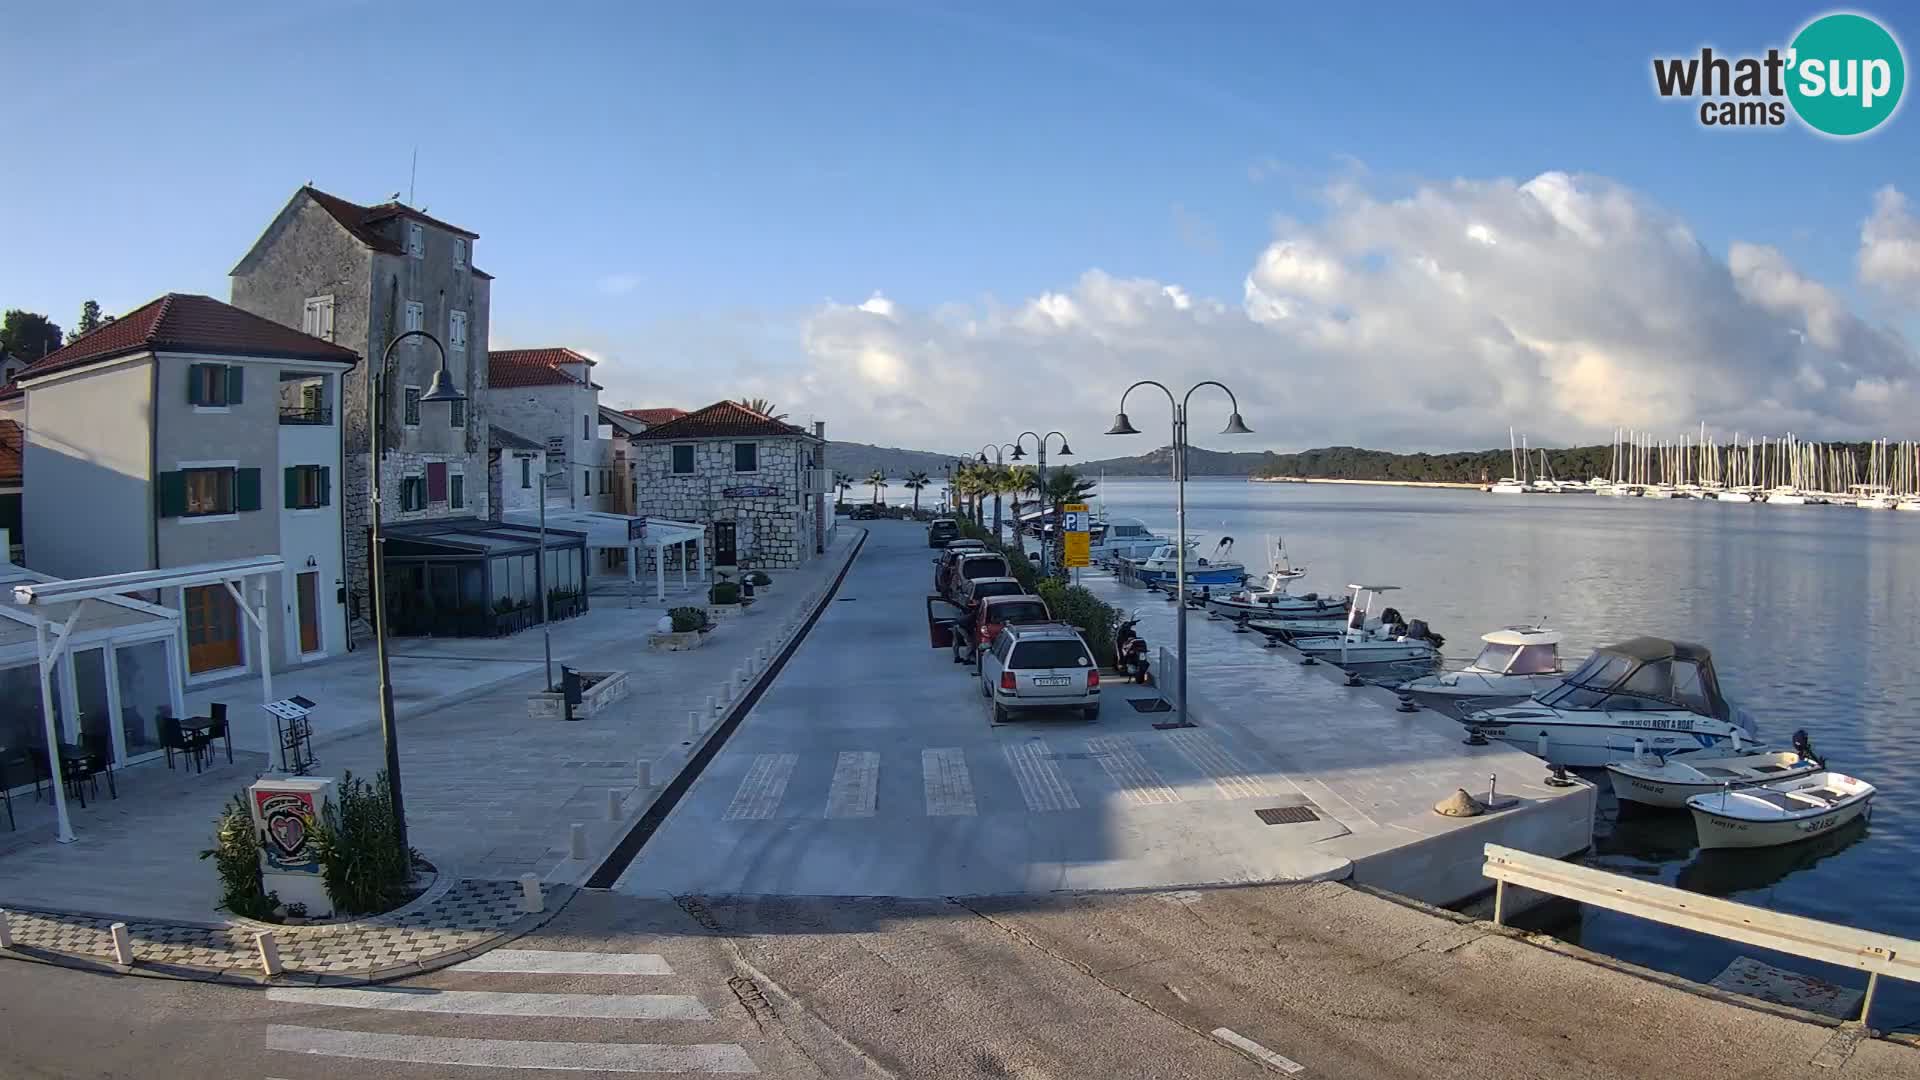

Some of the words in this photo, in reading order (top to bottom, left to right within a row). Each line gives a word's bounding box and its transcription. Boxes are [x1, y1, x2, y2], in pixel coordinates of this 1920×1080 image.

[1652, 719, 1670, 730] RENT
[1670, 720, 1677, 729] A
[1677, 720, 1695, 731] BOAT
